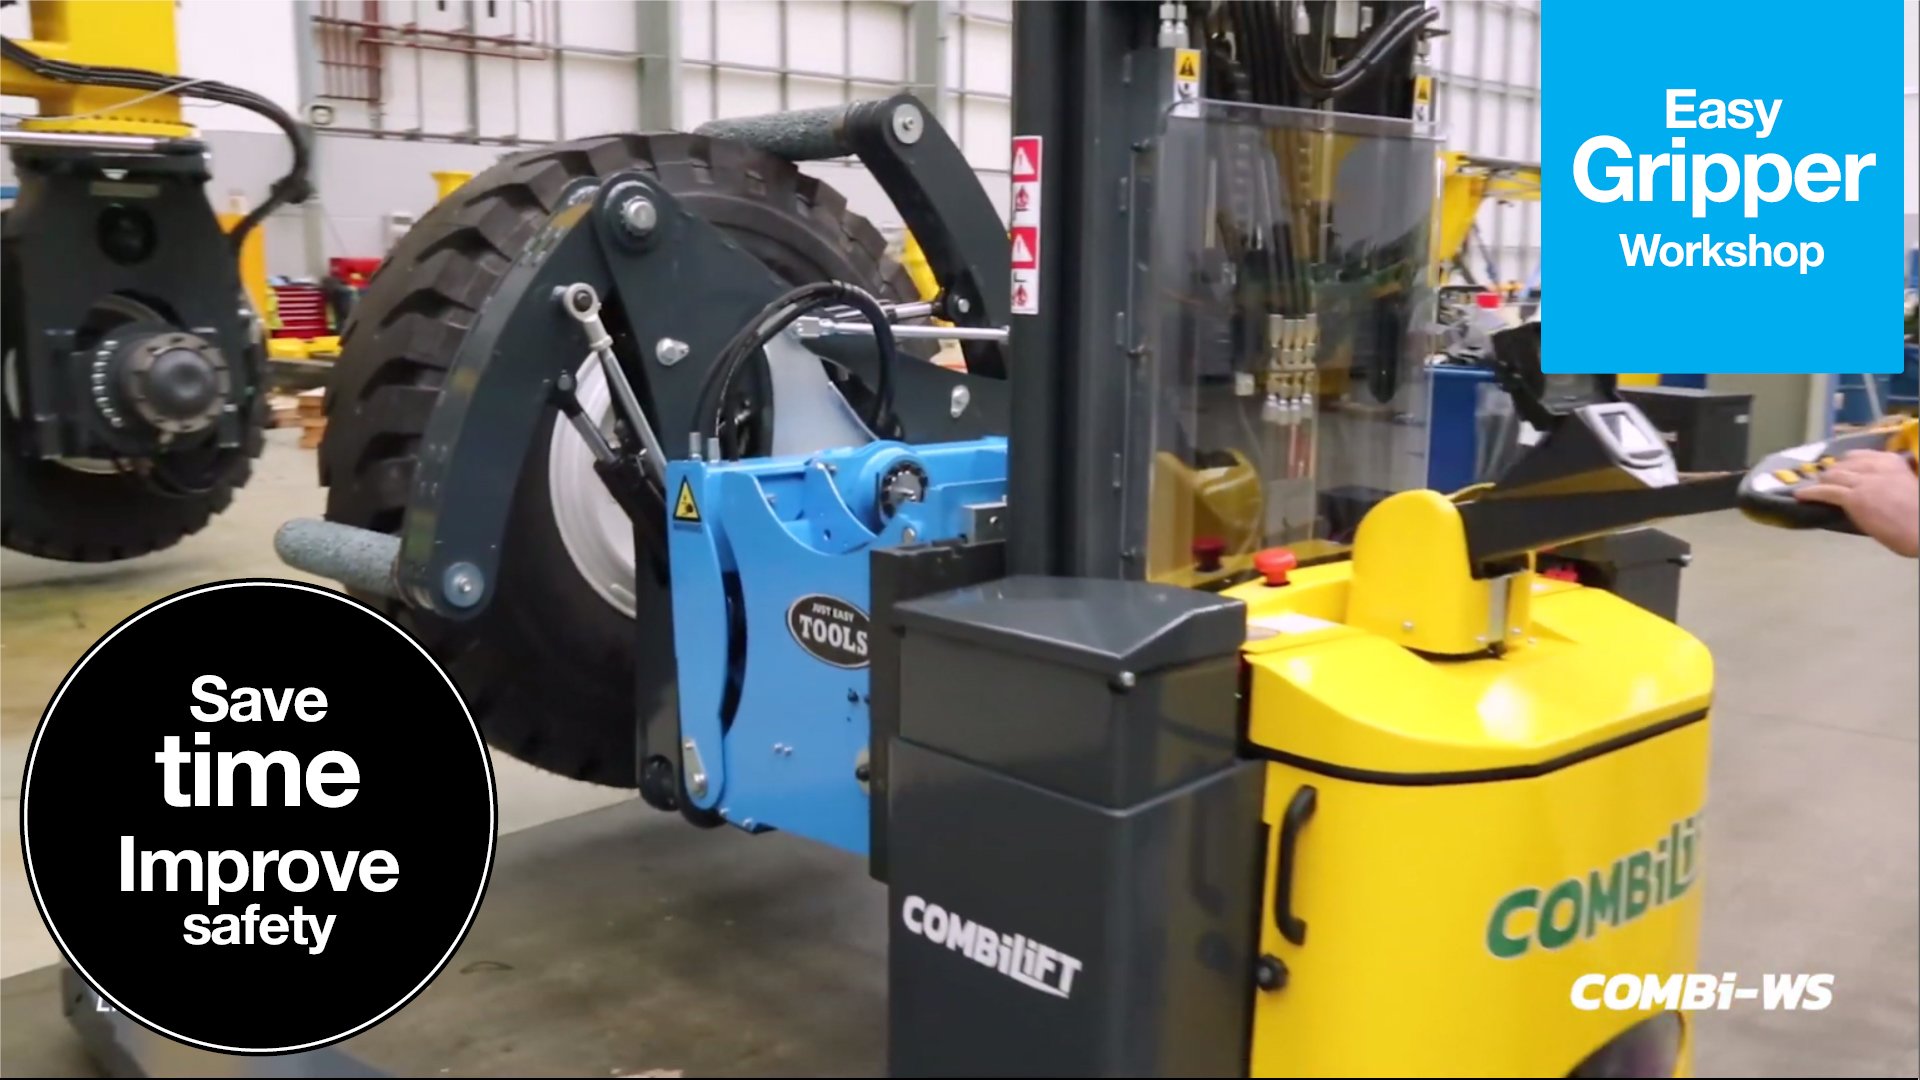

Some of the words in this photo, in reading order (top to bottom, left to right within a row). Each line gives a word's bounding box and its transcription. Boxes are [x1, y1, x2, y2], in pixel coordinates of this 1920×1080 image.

[812, 602, 832, 617] JUST
[832, 607, 855, 623] EASY
[799, 613, 869, 657] TOOLS
[1486, 814, 1705, 959] COMBiLi
